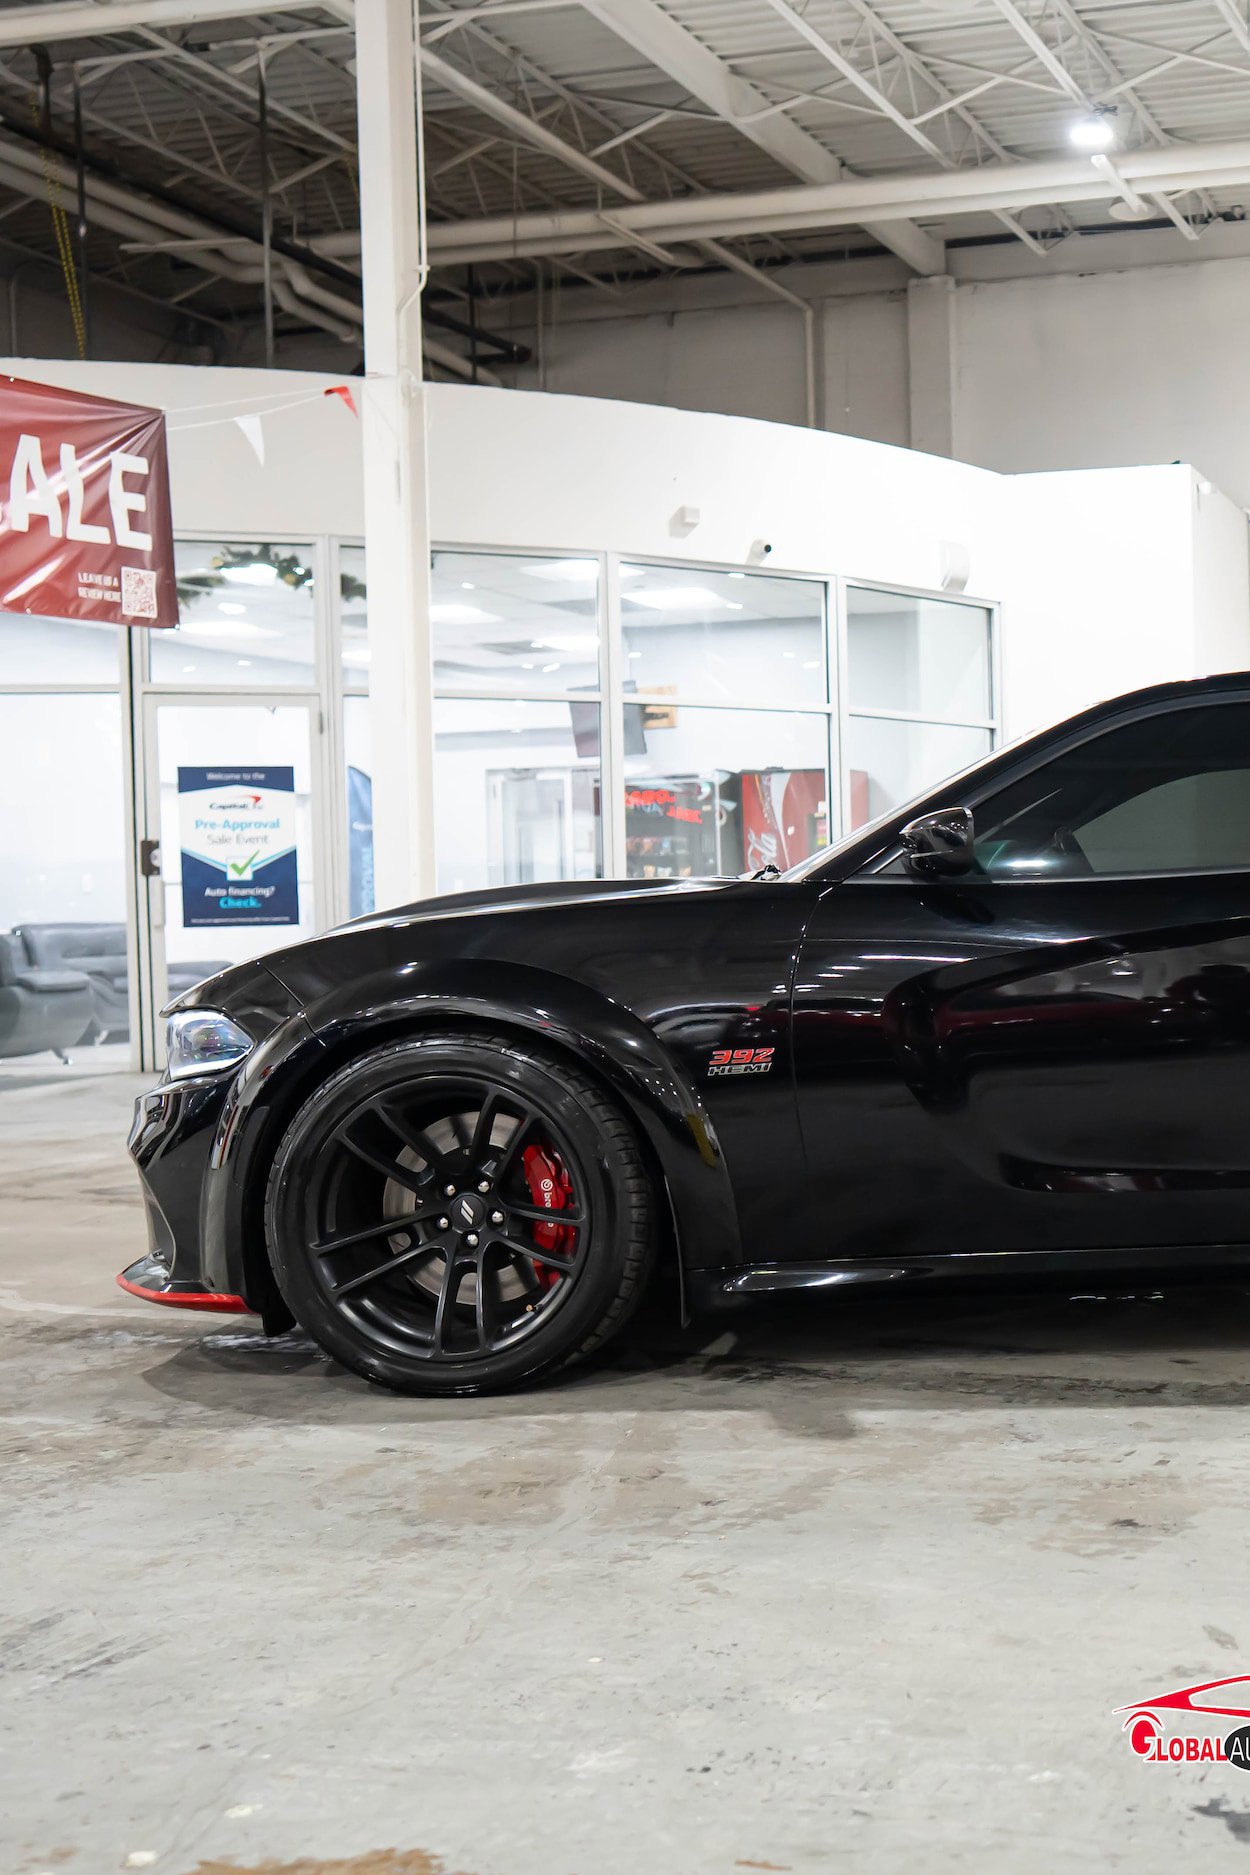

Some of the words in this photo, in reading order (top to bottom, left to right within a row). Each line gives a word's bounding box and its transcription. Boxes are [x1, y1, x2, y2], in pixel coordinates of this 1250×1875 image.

[0, 432, 152, 551] ALE
[195, 818, 280, 831] Pre-Approval
[207, 834, 232, 845] Sale
[236, 834, 268, 845] Event
[204, 887, 227, 897] Auto
[228, 886, 275, 898] financing?
[708, 1047, 775, 1065] 392
[707, 1062, 772, 1076] HEMI
